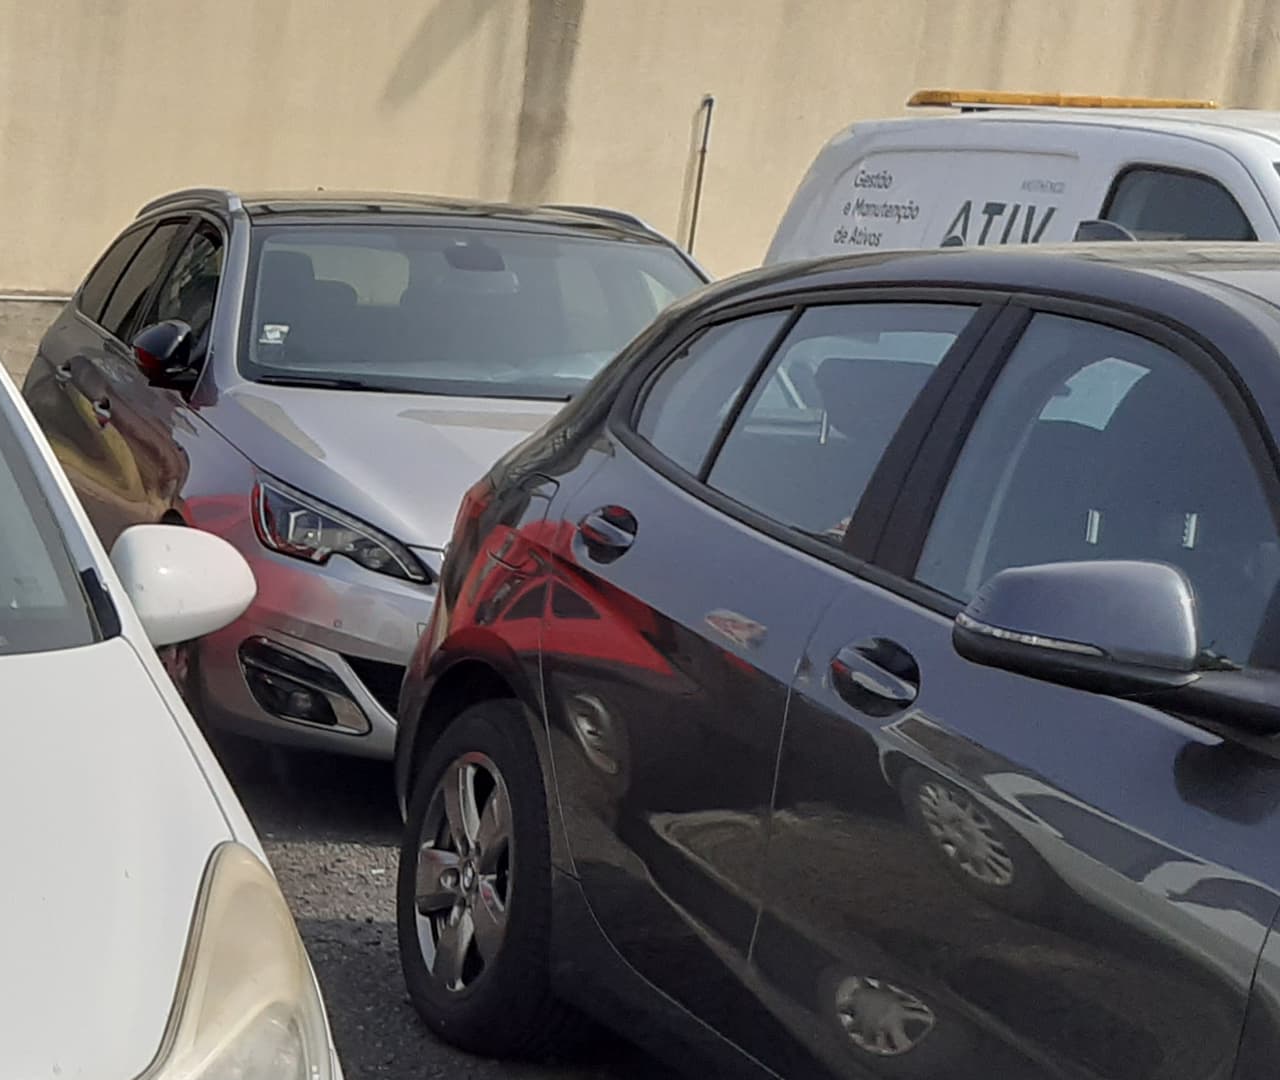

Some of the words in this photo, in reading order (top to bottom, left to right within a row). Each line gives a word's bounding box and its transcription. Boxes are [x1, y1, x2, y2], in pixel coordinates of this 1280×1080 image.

[854, 169, 893, 190] Gestão
[842, 201, 852, 216] e
[852, 197, 920, 224] Manutenção
[833, 225, 848, 244] de
[849, 226, 883, 247] Ativos
